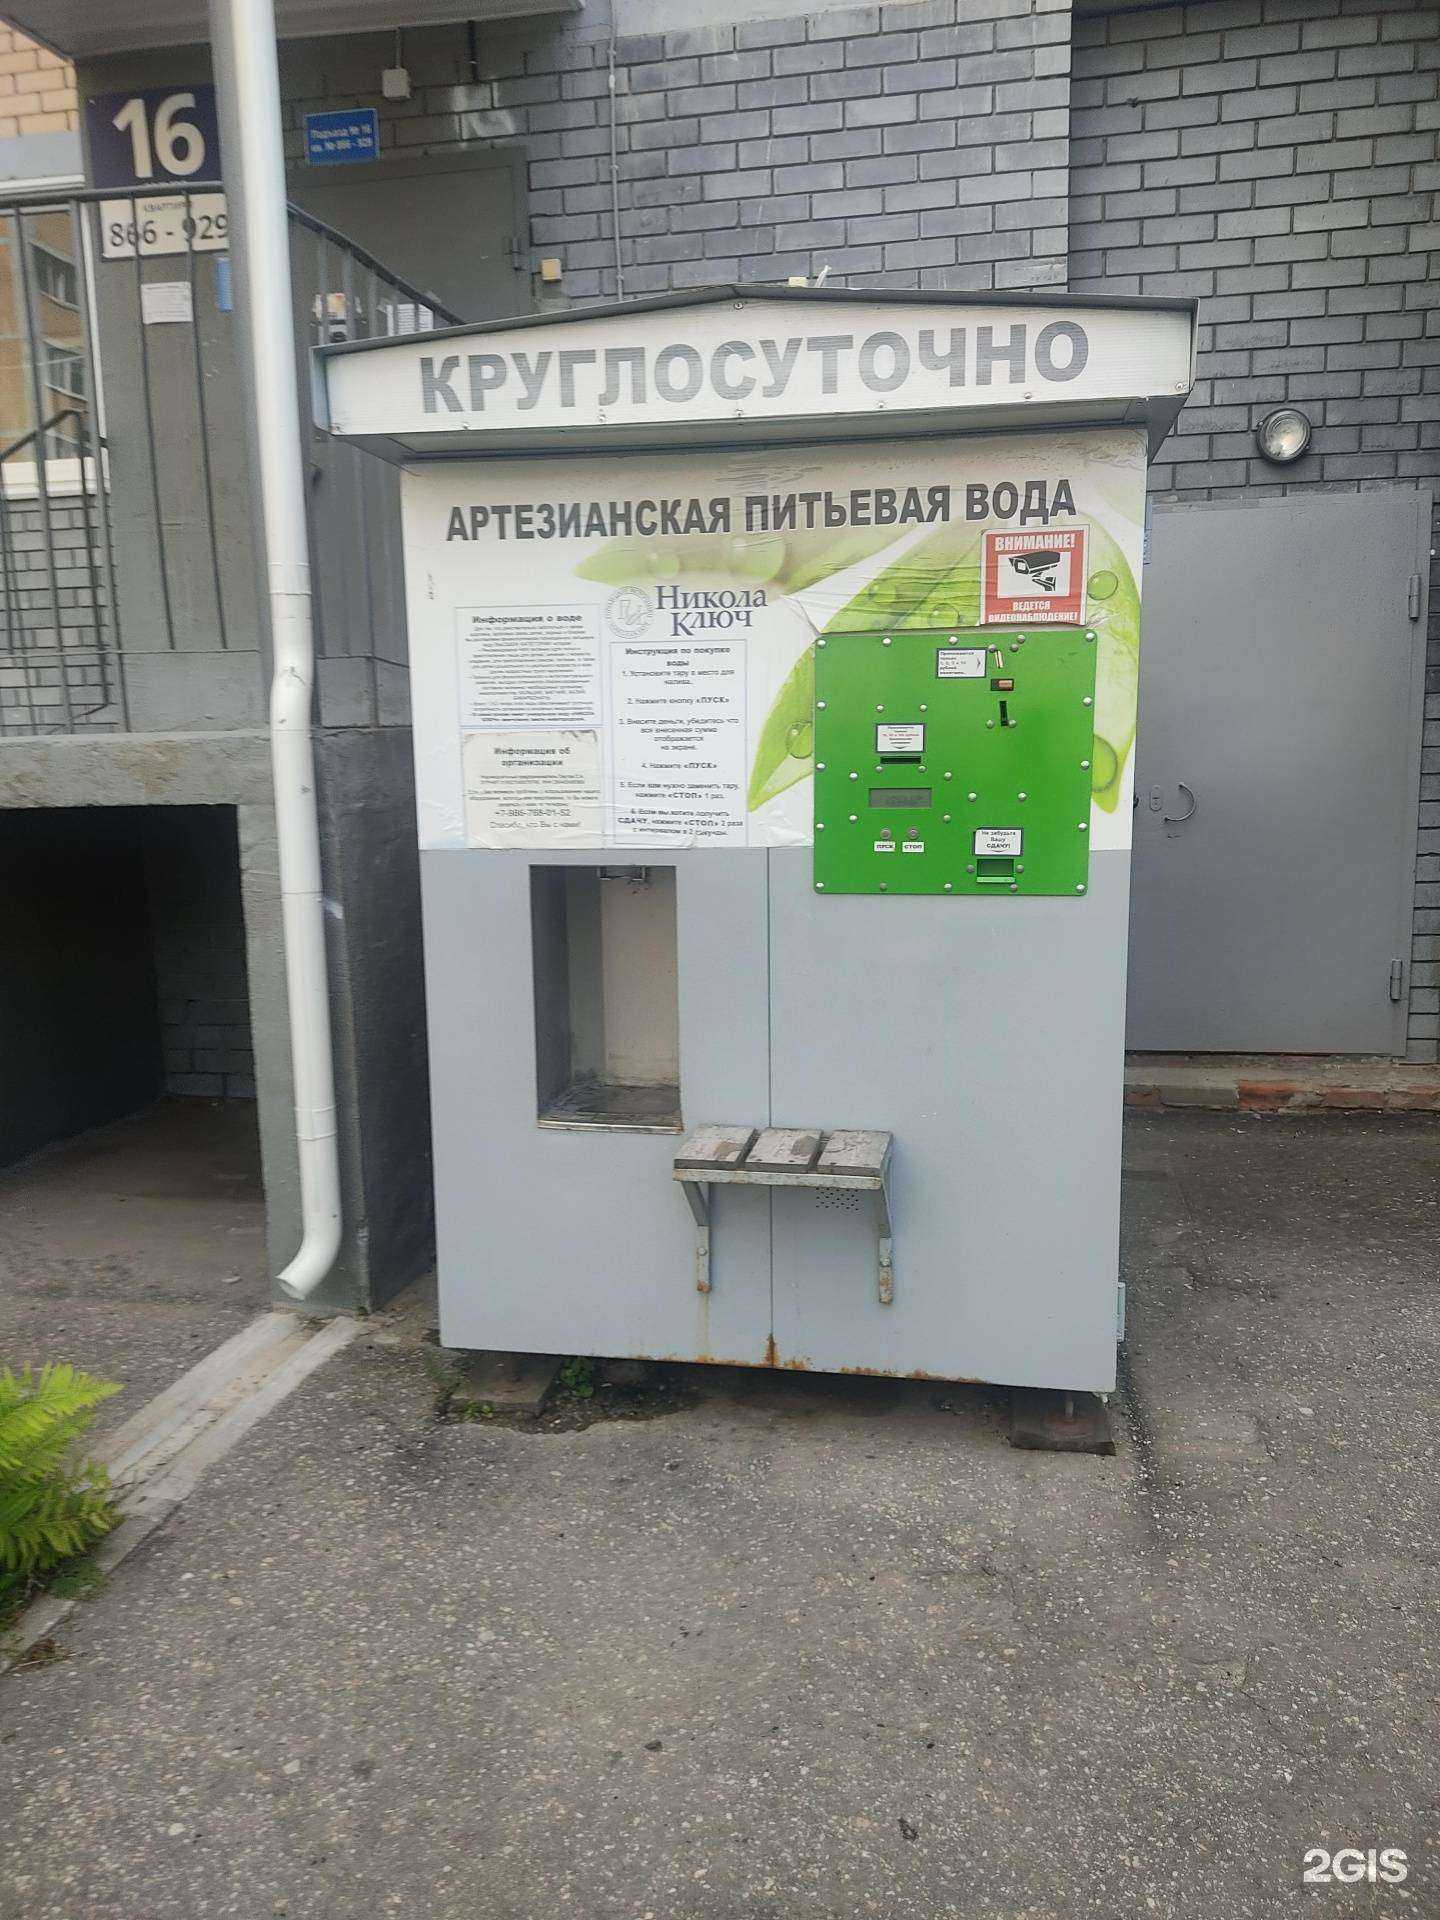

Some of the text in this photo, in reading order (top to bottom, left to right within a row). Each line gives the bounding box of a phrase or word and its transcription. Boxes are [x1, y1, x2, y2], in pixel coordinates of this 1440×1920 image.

[112, 93, 205, 178] 16
[110, 220, 157, 247] 866
[419, 320, 1089, 414] КРУГЛОСУТОЧНО
[446, 479, 1077, 541] АРТЕЗИАНСКАЯ ПИТЬЕВАЯ ВОДА
[995, 533, 1075, 551] ВНИМАНИЕ!
[655, 585, 768, 610] Никола
[472, 615, 543, 624] Информация
[671, 610, 753, 636] Ключ
